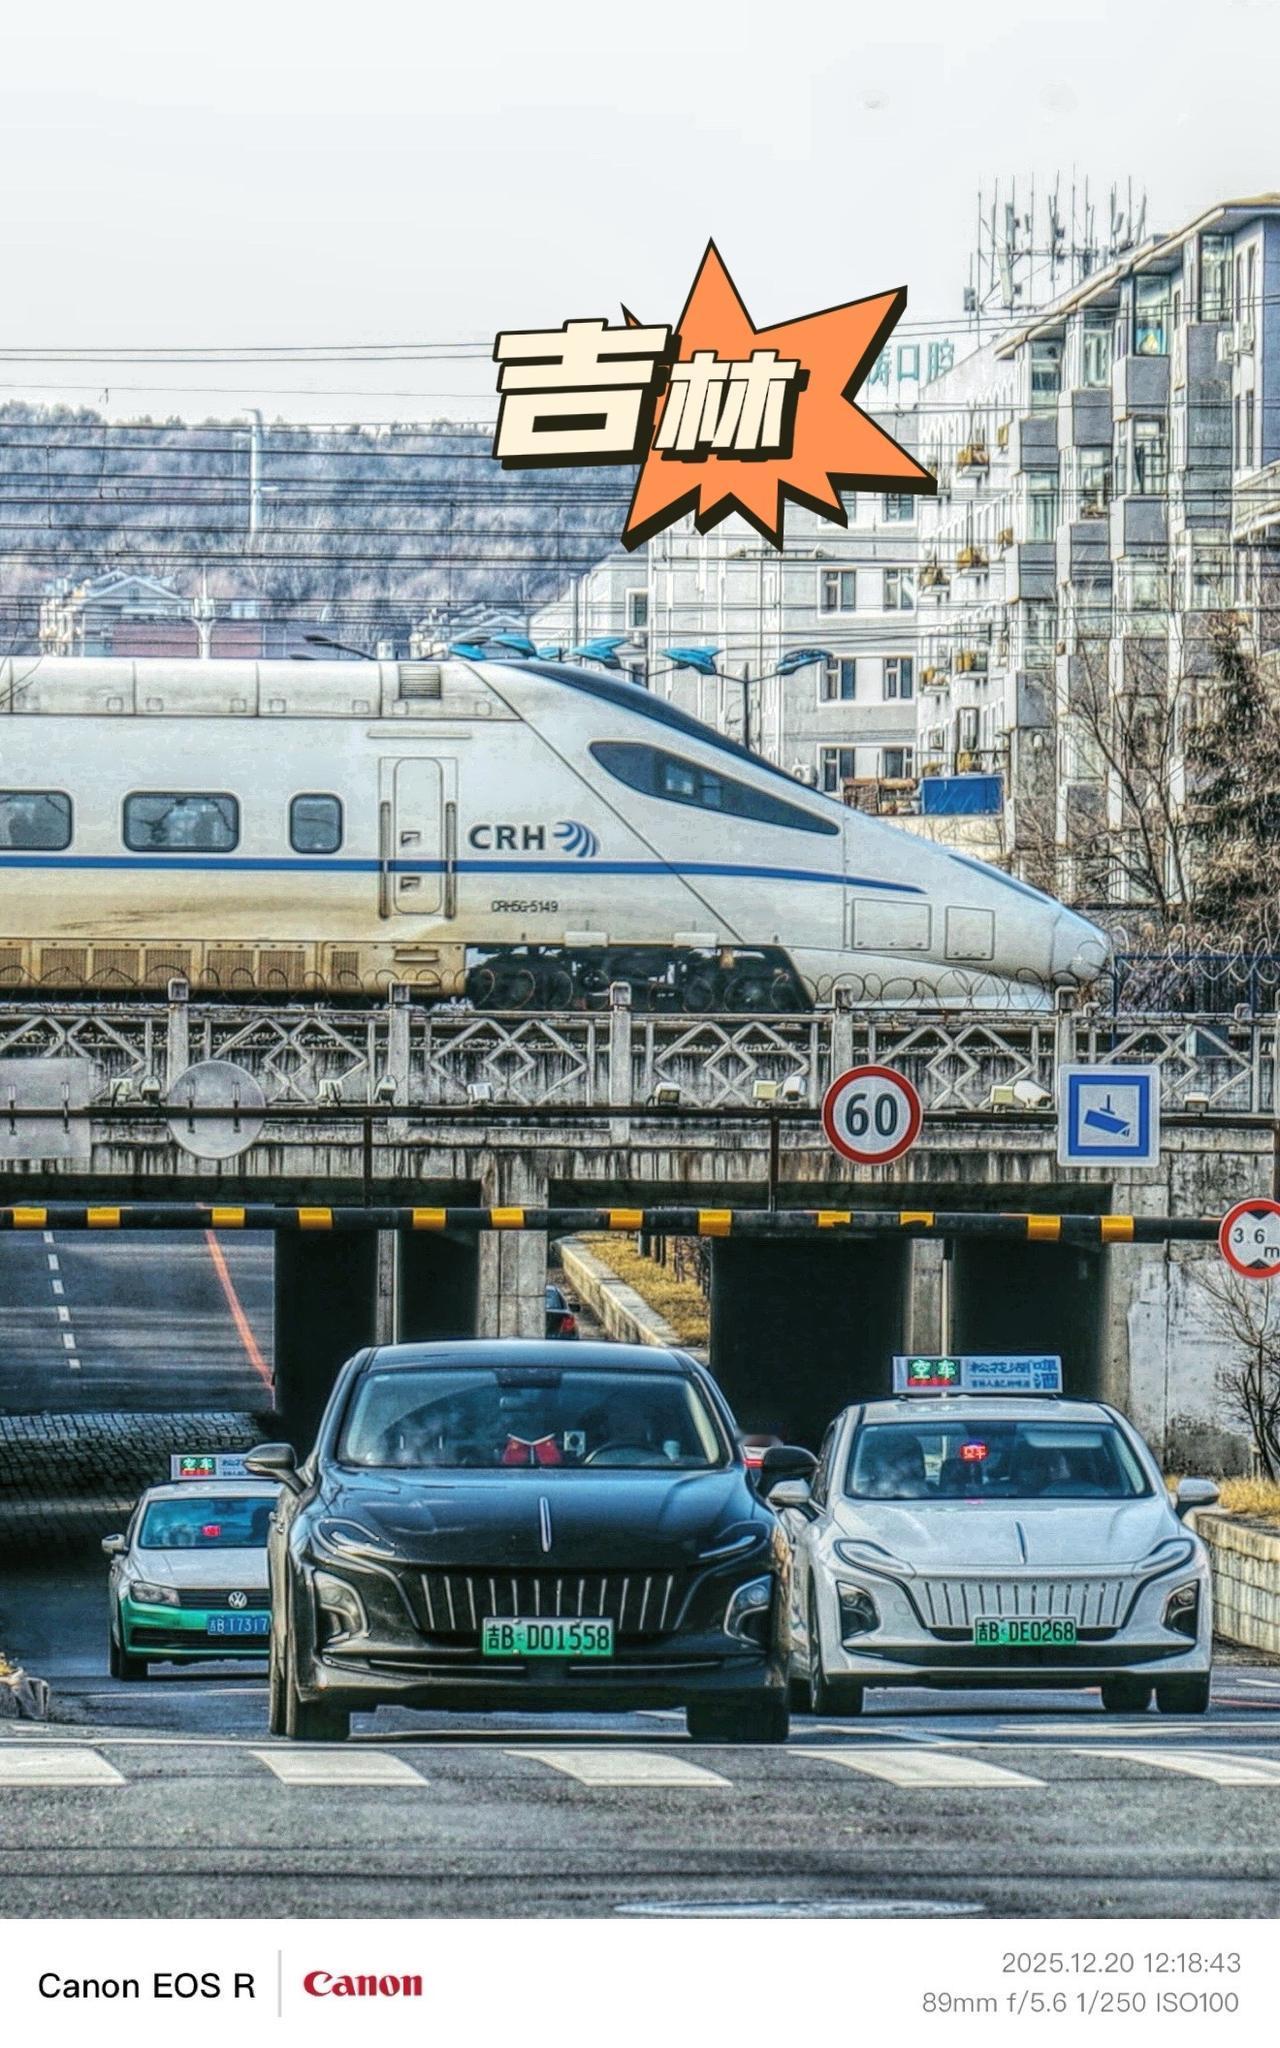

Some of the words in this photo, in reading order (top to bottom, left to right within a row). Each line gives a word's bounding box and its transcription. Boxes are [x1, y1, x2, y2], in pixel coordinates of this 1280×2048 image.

[469, 824, 545, 850] CRH
[491, 900, 559, 913] CRH5G-5149
[845, 1092, 898, 1137] 60
[1233, 1227, 1266, 1244] 3.6
[1264, 1246, 1280, 1258] m
[911, 1359, 956, 1380] 空车
